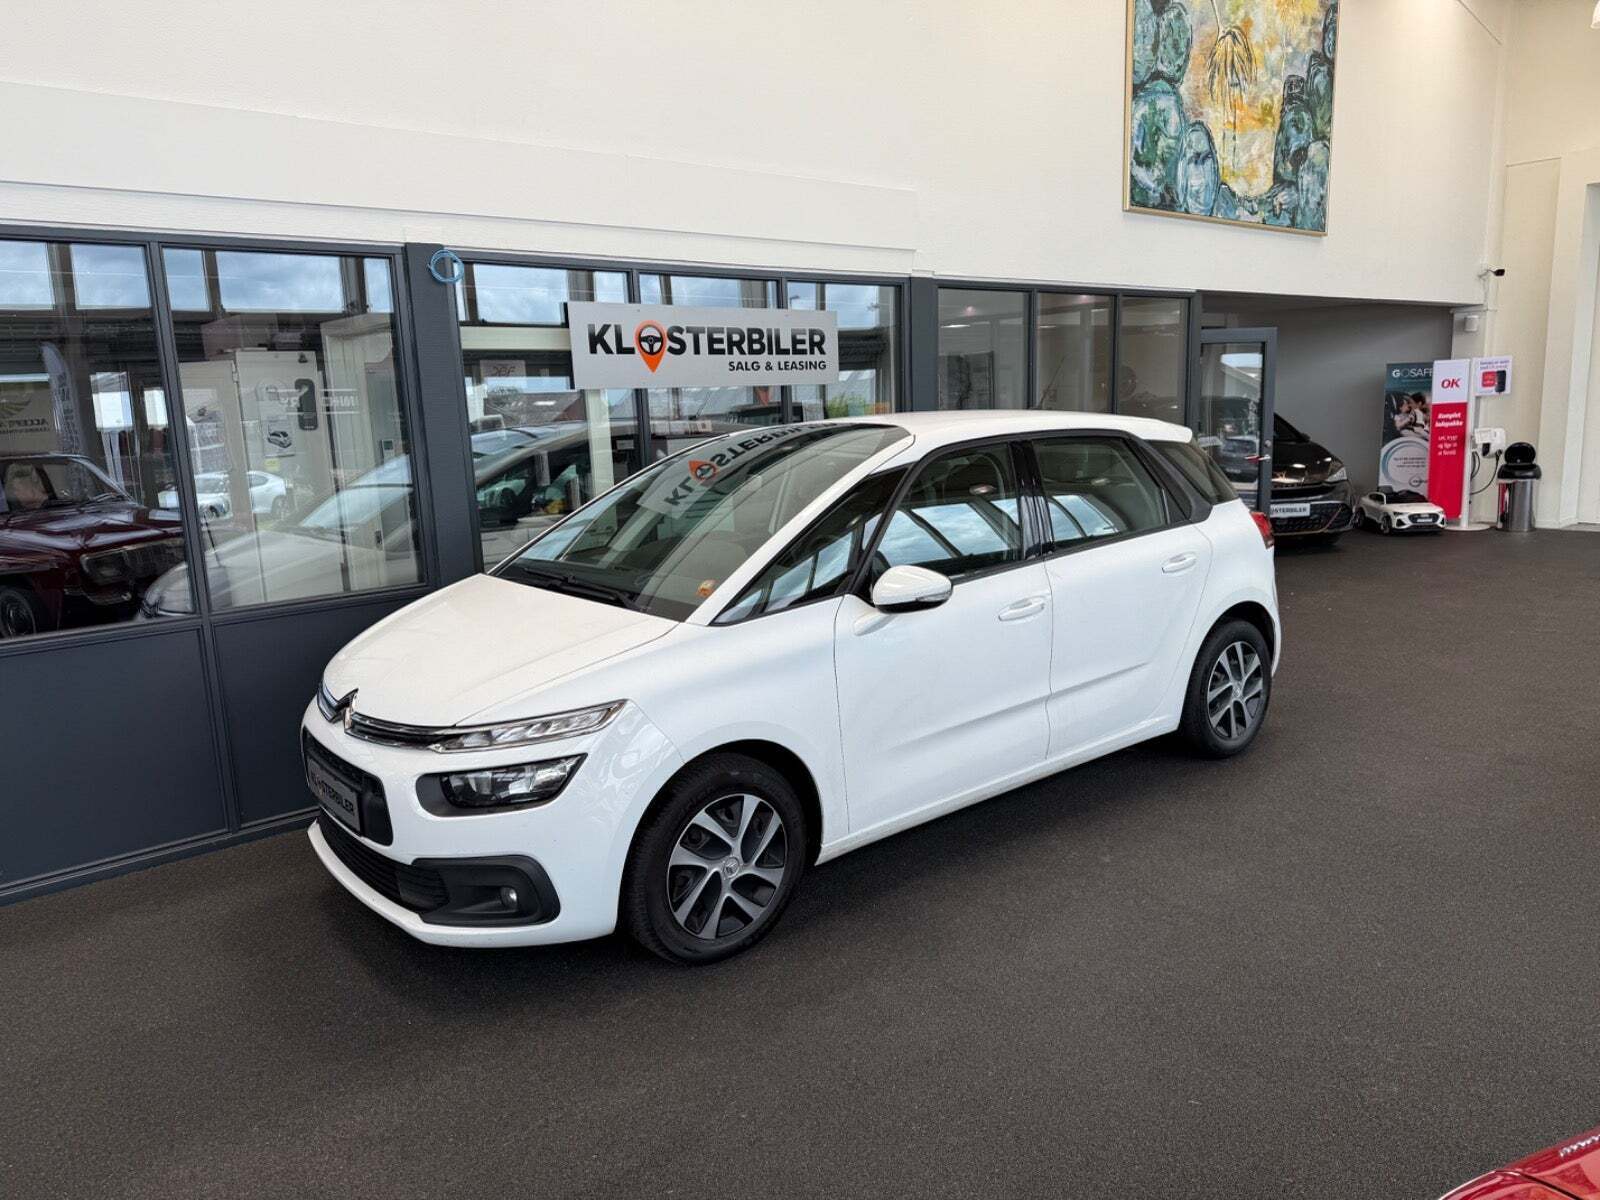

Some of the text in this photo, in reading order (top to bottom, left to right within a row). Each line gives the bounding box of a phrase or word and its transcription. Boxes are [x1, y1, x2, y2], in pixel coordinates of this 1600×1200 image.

[587, 321, 827, 357] KLOSTERBILER
[728, 360, 827, 371] SALG & LEASING
[1441, 378, 1461, 389] OK
